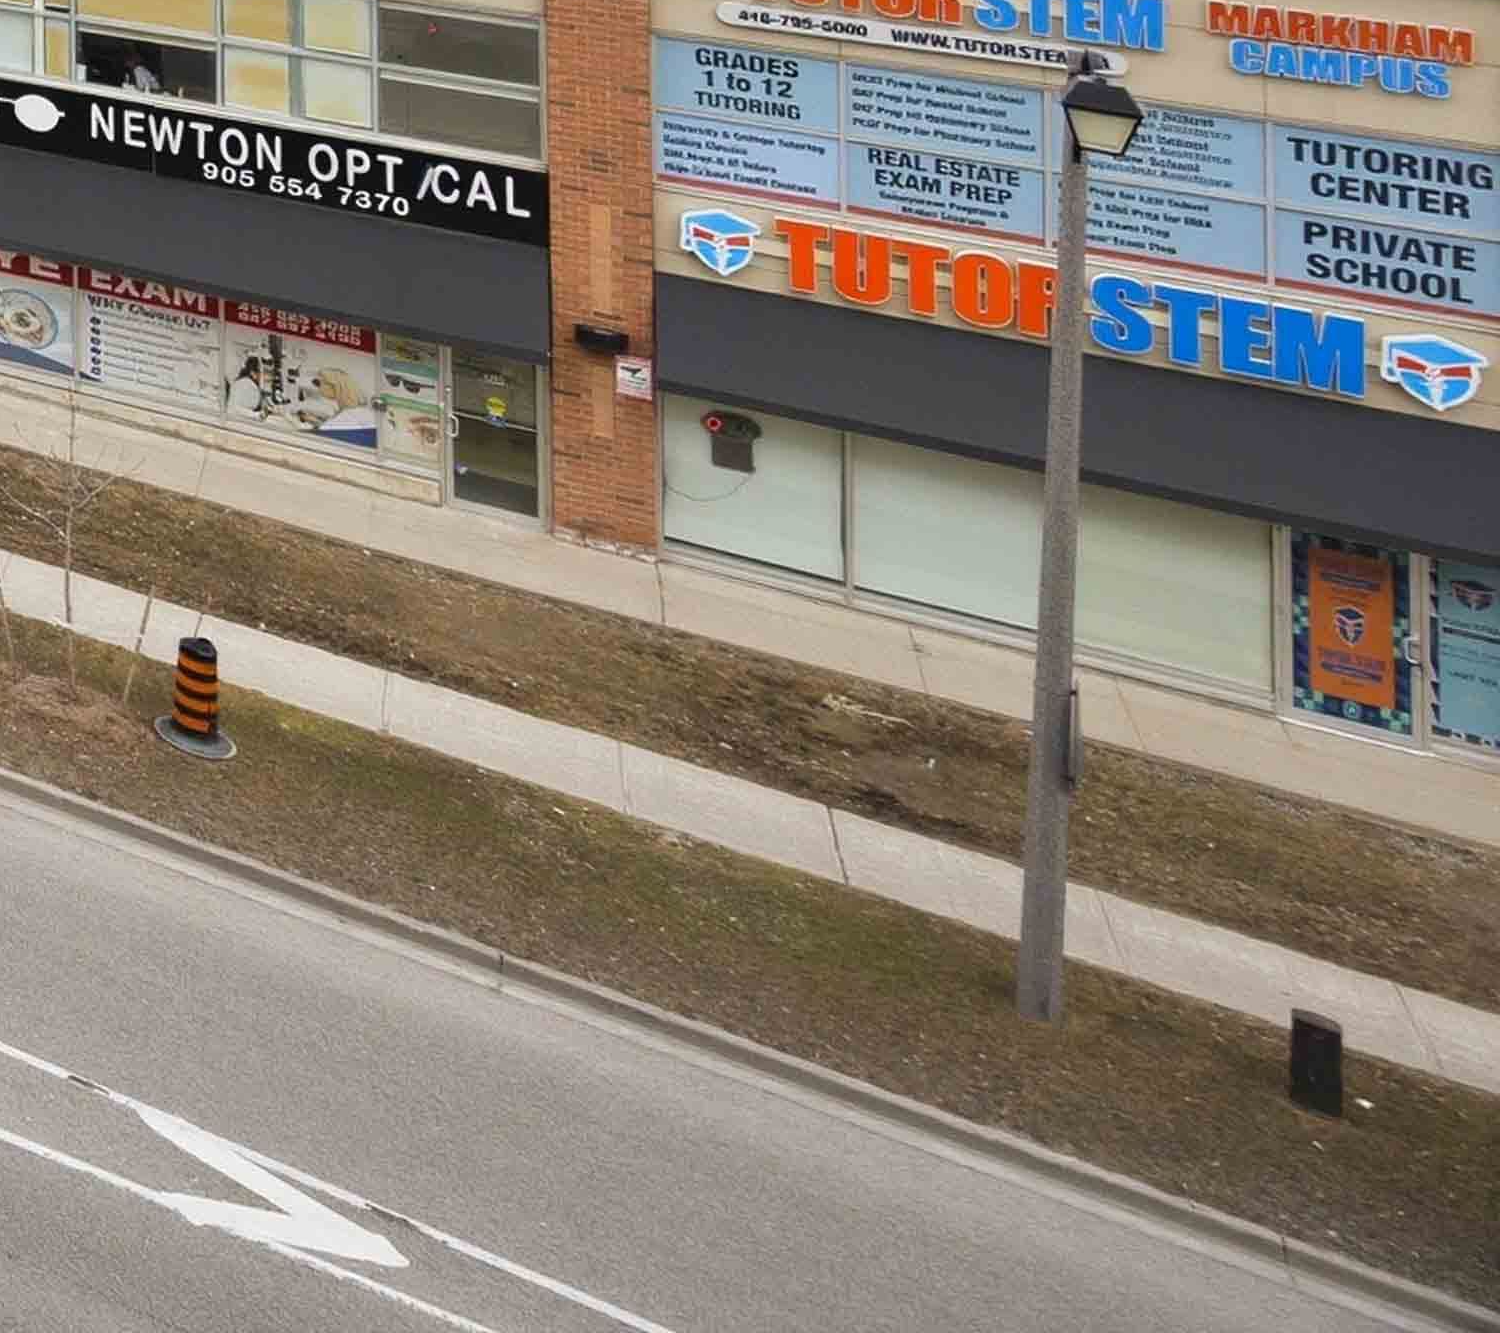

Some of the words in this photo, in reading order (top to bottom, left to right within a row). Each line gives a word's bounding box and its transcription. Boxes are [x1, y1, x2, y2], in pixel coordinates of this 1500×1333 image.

[1207, 0, 1476, 66] MARKHAM
[695, 47, 799, 79] GRADES
[705, 72, 714, 87] 1
[725, 74, 751, 92] to
[763, 79, 794, 99] 12
[1229, 38, 1453, 100] CAMPUS
[694, 91, 801, 120] TUTORING
[89, 102, 283, 175] NEWTON
[1286, 136, 1494, 190] TUTORING
[202, 162, 255, 188] 905
[269, 175, 323, 200] 554
[336, 187, 410, 216] 7370
[867, 147, 927, 172] REAL
[935, 158, 1021, 187] ESTATE
[875, 169, 942, 194] EXAM
[950, 181, 1013, 205] PREP
[1310, 172, 1471, 219] CENTER
[1303, 220, 1477, 273] PRIVATE
[90, 271, 208, 312] EXAM
[1306, 254, 1474, 304] SCHOOL
[1090, 273, 1366, 399] STEM
